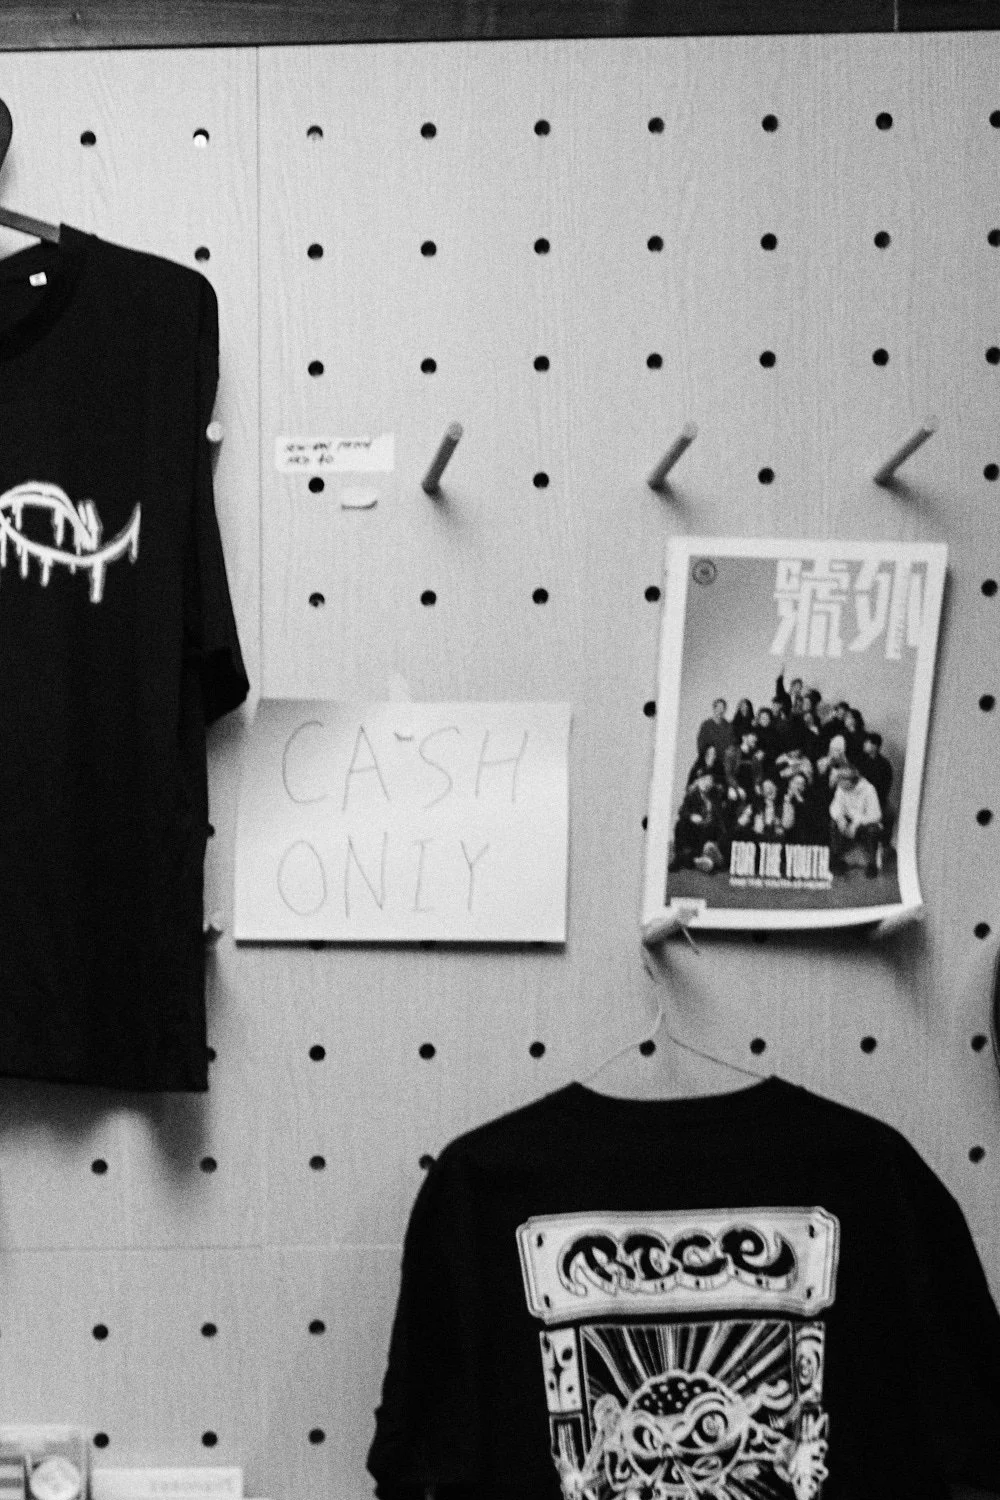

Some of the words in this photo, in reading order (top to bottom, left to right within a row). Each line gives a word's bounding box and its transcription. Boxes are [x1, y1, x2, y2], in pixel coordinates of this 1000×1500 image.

[281, 720, 529, 812] CASH
[729, 841, 757, 875] FOR
[758, 842, 782, 877] THE
